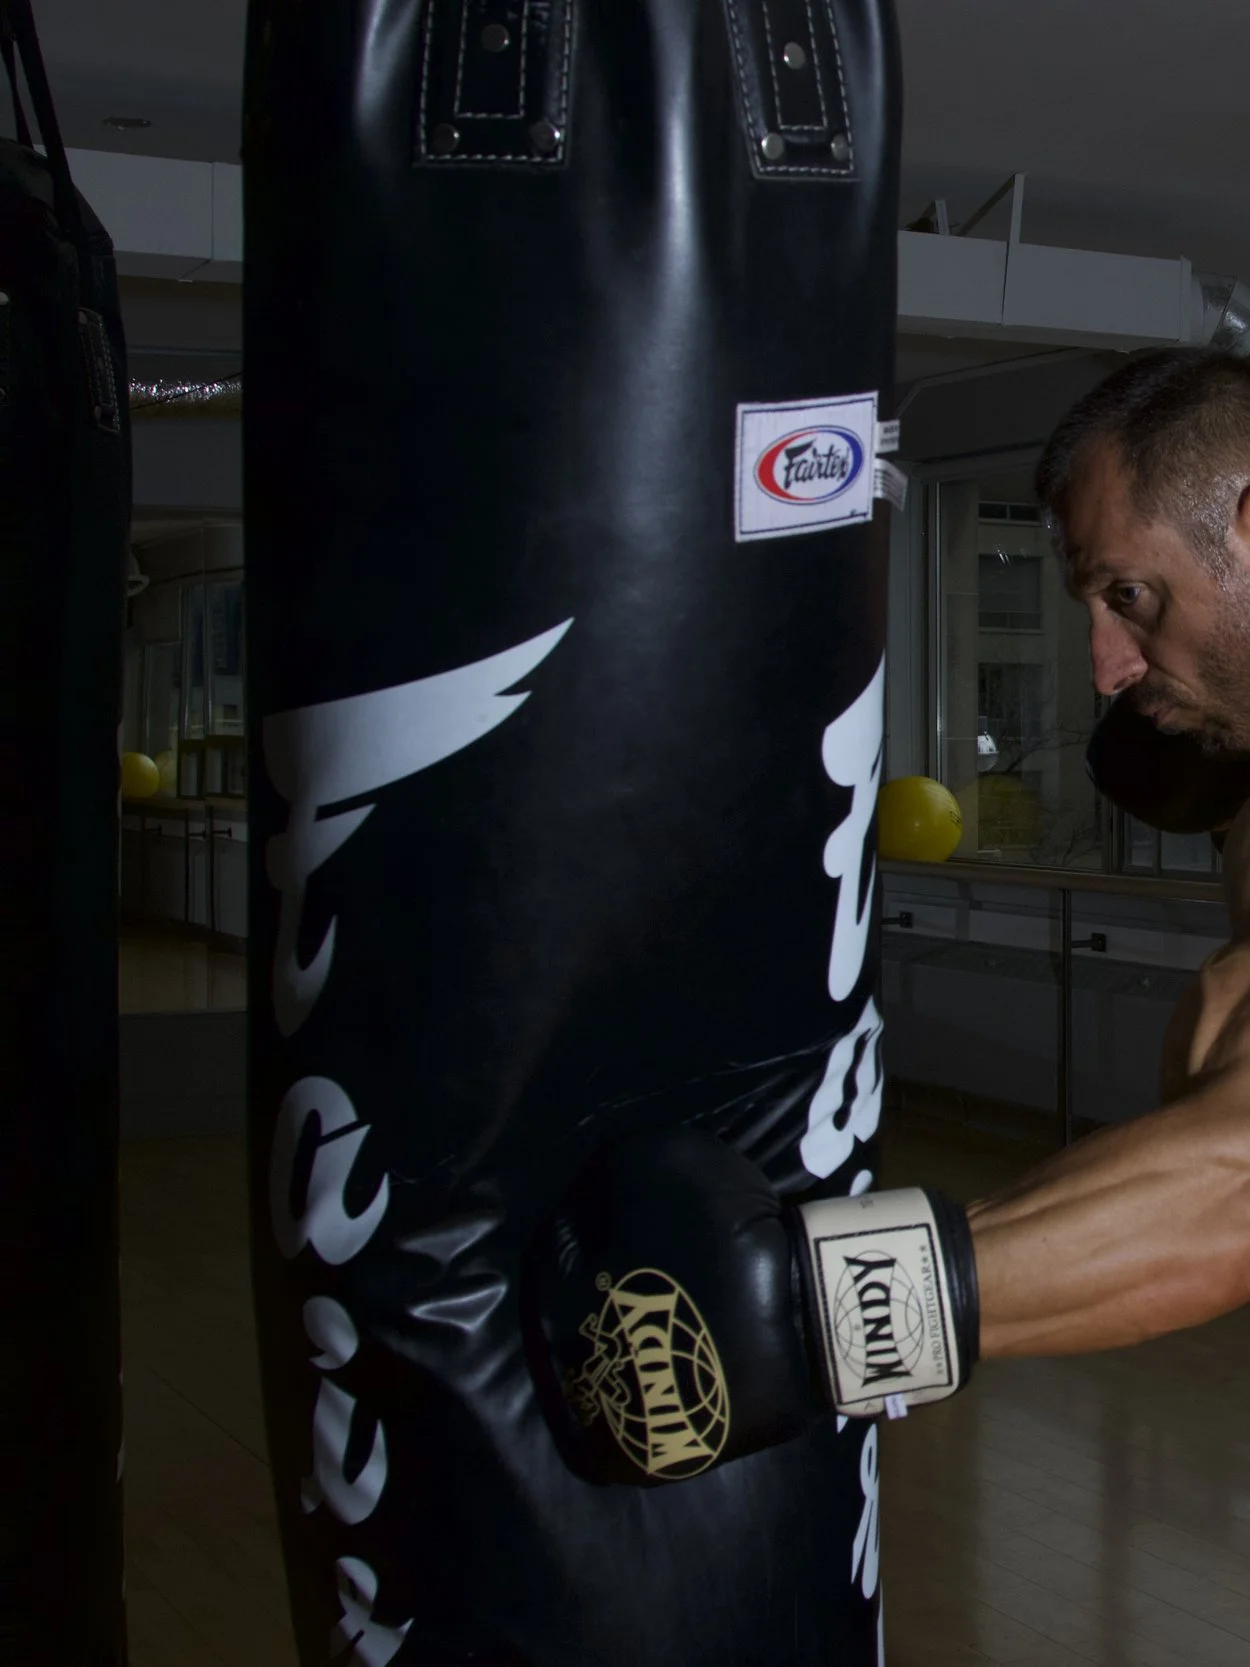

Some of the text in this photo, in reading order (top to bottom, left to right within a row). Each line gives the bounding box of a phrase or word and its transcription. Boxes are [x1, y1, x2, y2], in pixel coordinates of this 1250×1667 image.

[784, 439, 849, 489] Fairtex
[843, 1256, 912, 1388] WINDY
[922, 1265, 943, 1361] PRO FIGHTGEAR
[609, 1288, 715, 1475] WINDY
